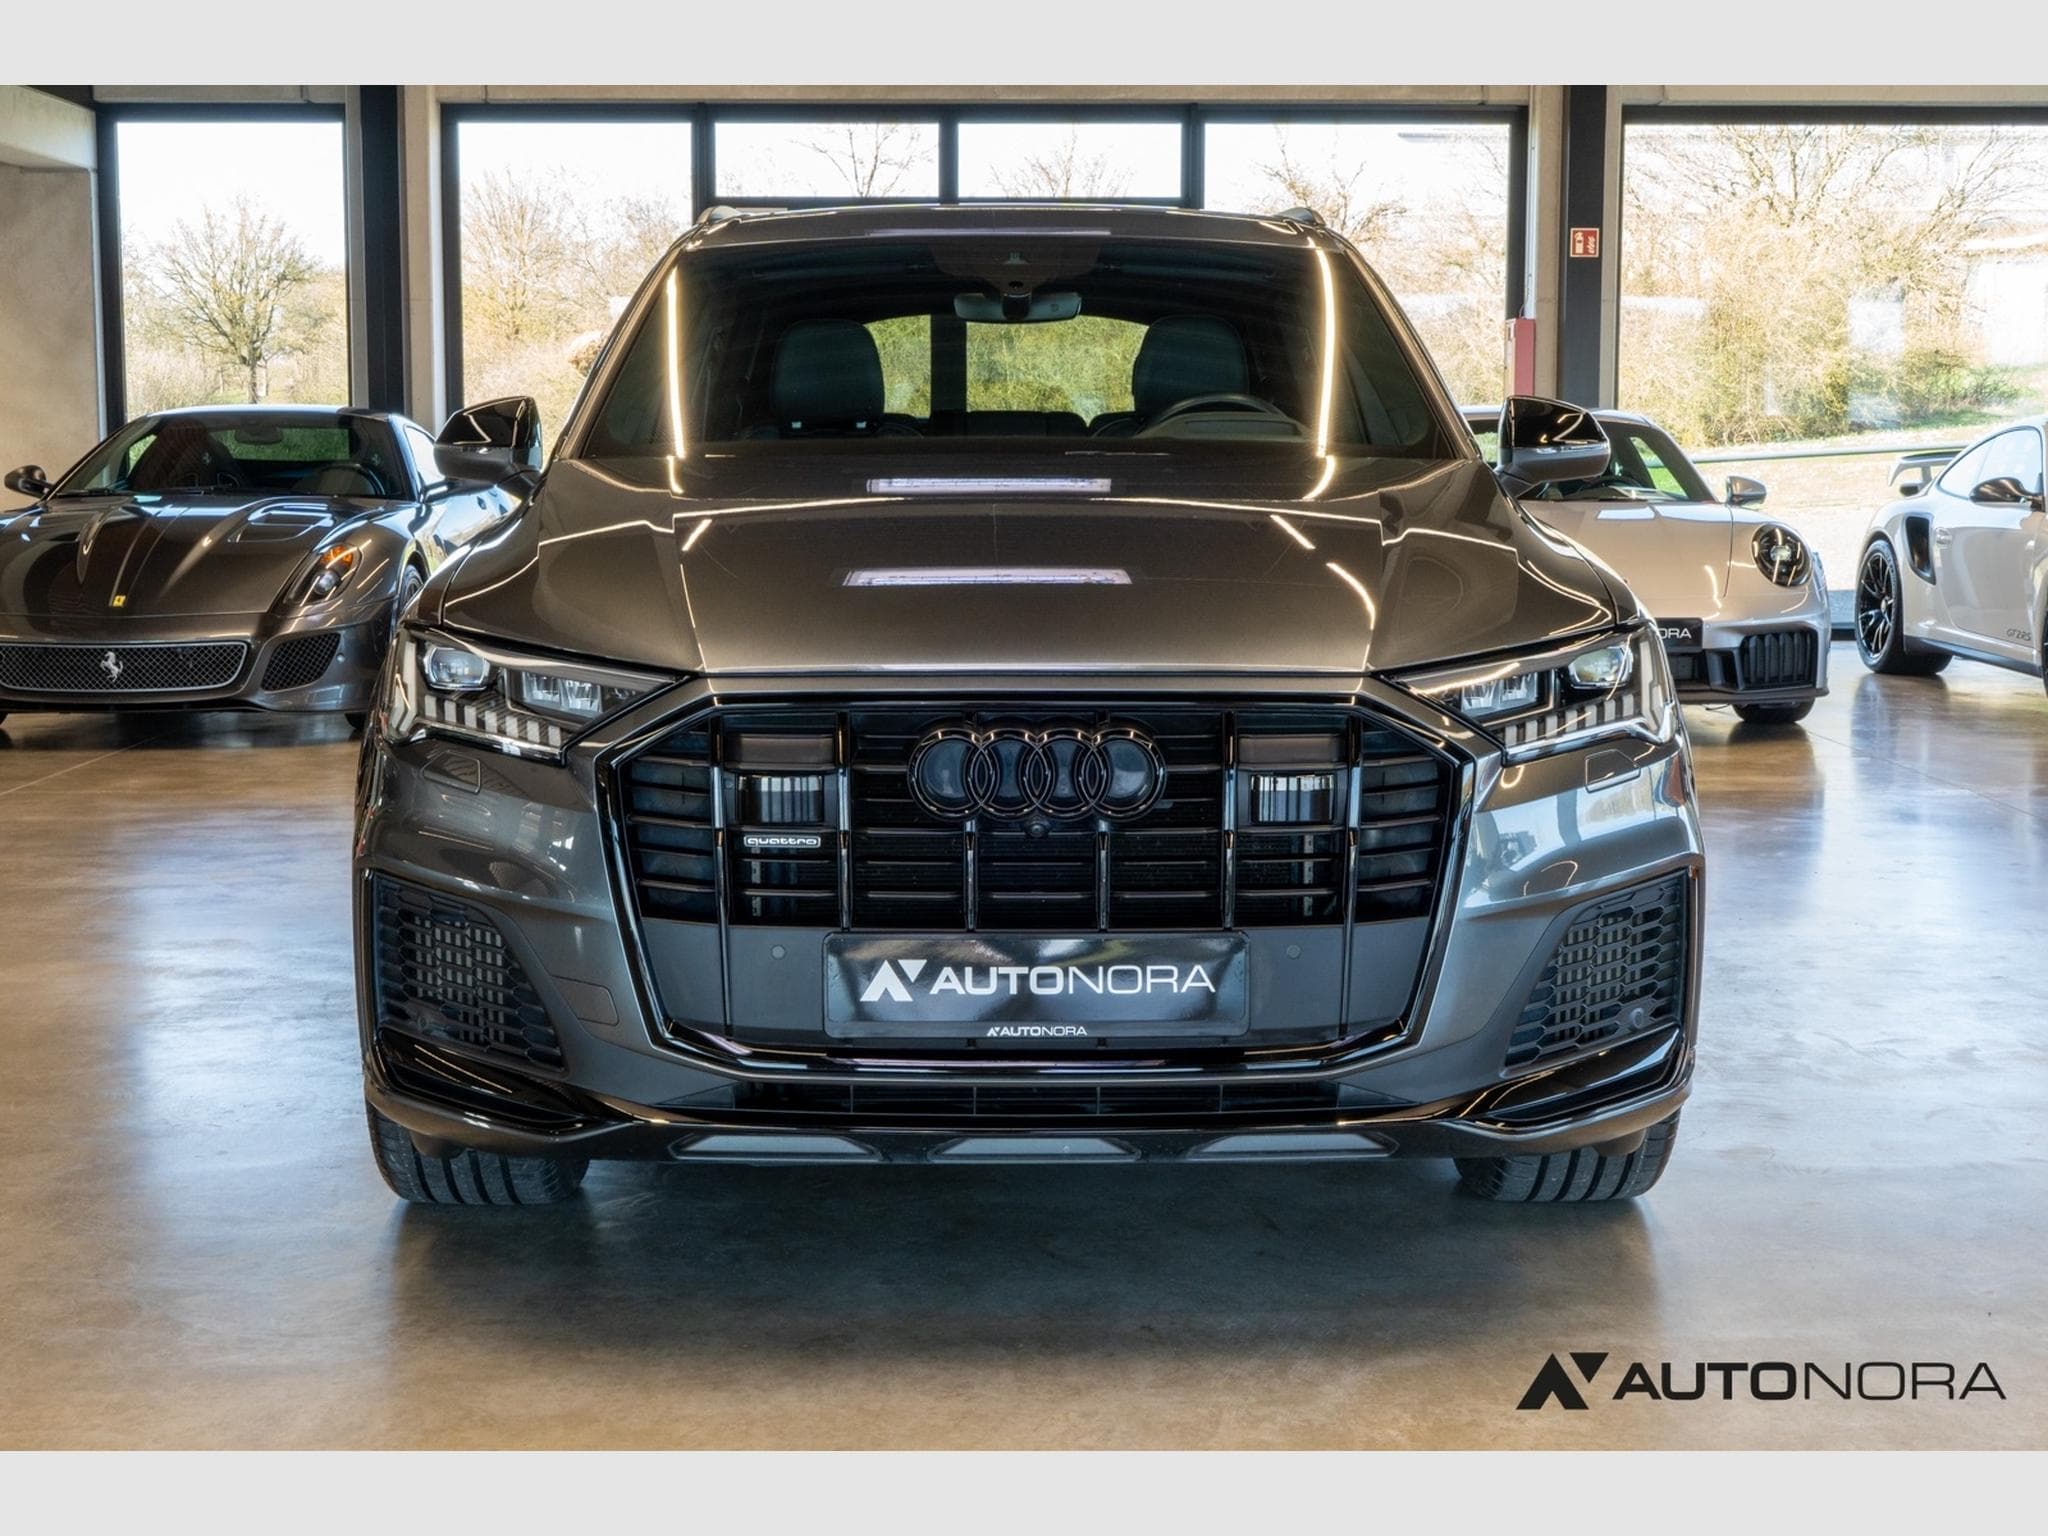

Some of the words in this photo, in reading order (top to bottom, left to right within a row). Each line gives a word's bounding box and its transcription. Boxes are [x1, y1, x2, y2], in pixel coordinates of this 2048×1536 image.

[747, 837, 818, 847] quattro
[929, 964, 1216, 996] AUTONORA
[1000, 1026, 1088, 1037] AUTONORA
